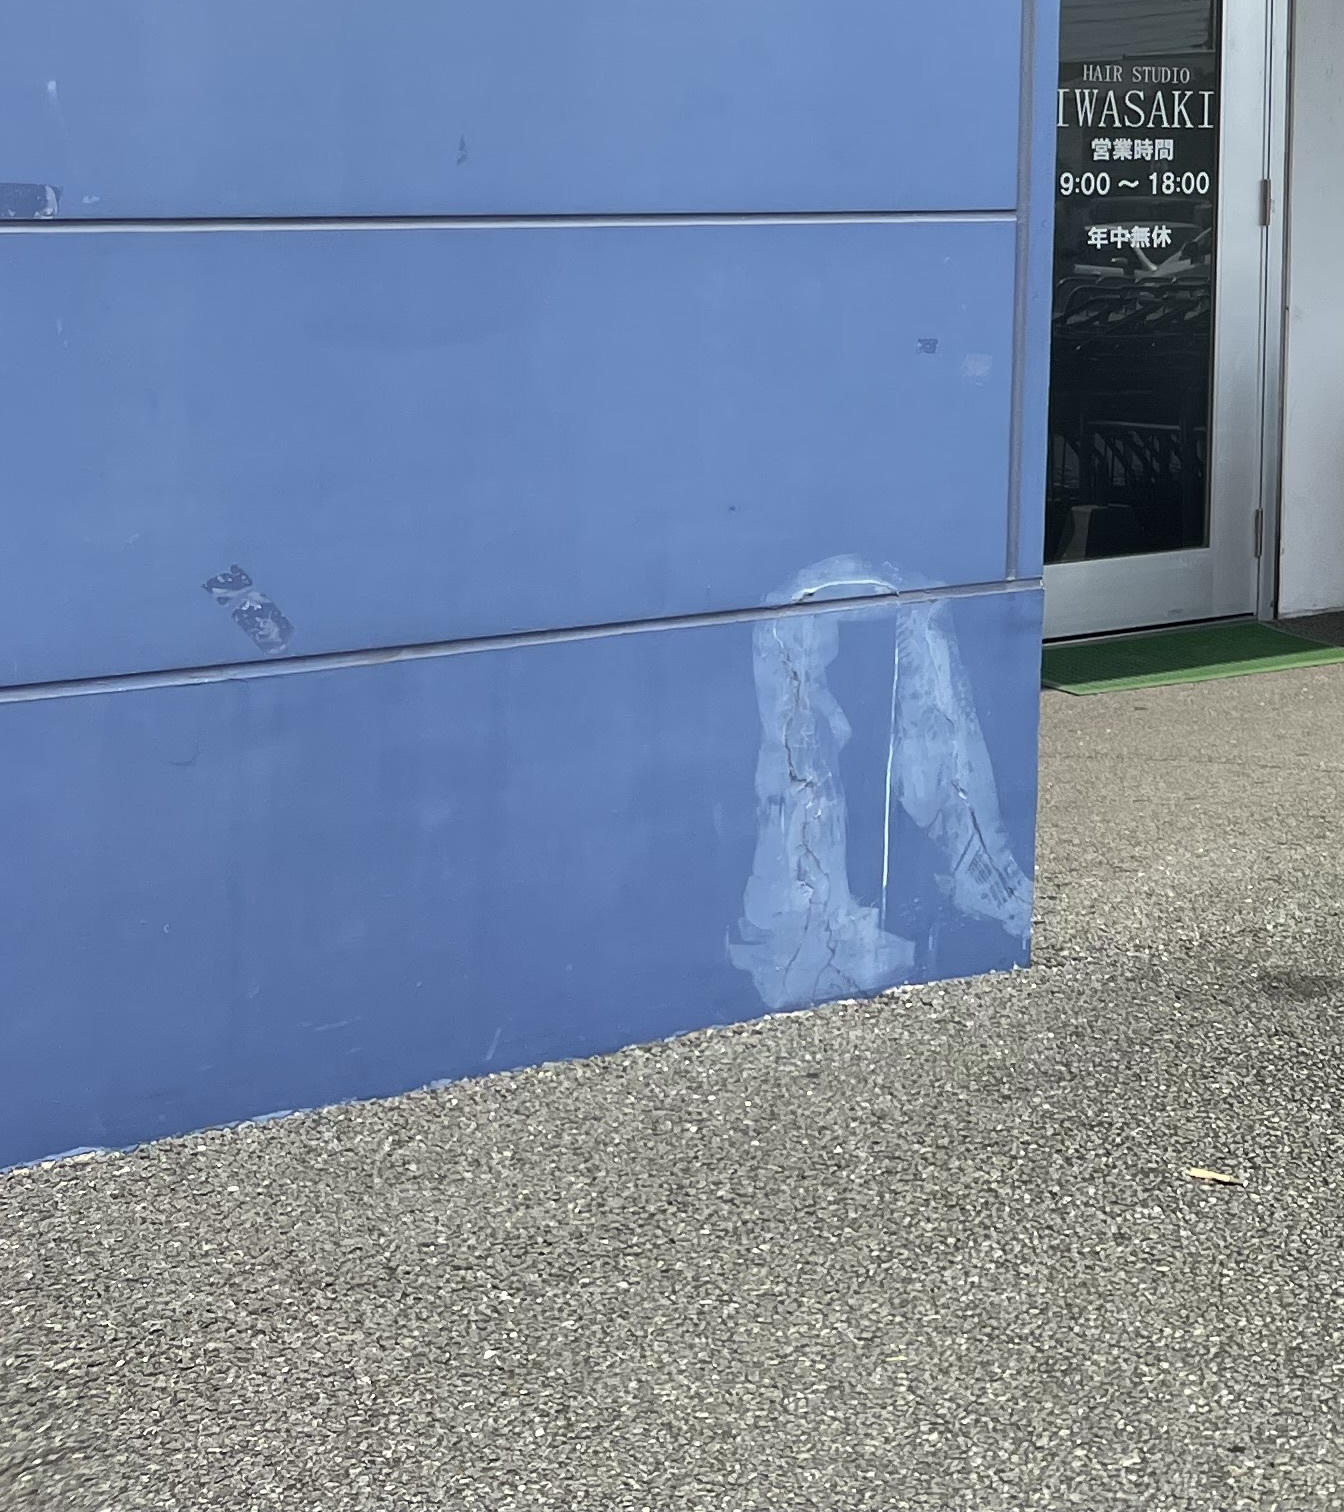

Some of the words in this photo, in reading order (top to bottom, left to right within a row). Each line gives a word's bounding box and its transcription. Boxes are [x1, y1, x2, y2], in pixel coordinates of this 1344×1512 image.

[1083, 64, 1124, 83] HAIR
[1131, 66, 1191, 84] STUDIO
[1057, 88, 1216, 129] IWASAKI
[1090, 137, 1175, 162] 営業時間
[1059, 171, 1112, 196] 9:00
[1148, 170, 1211, 196] 18:00
[1086, 224, 1173, 249] 年中無休
